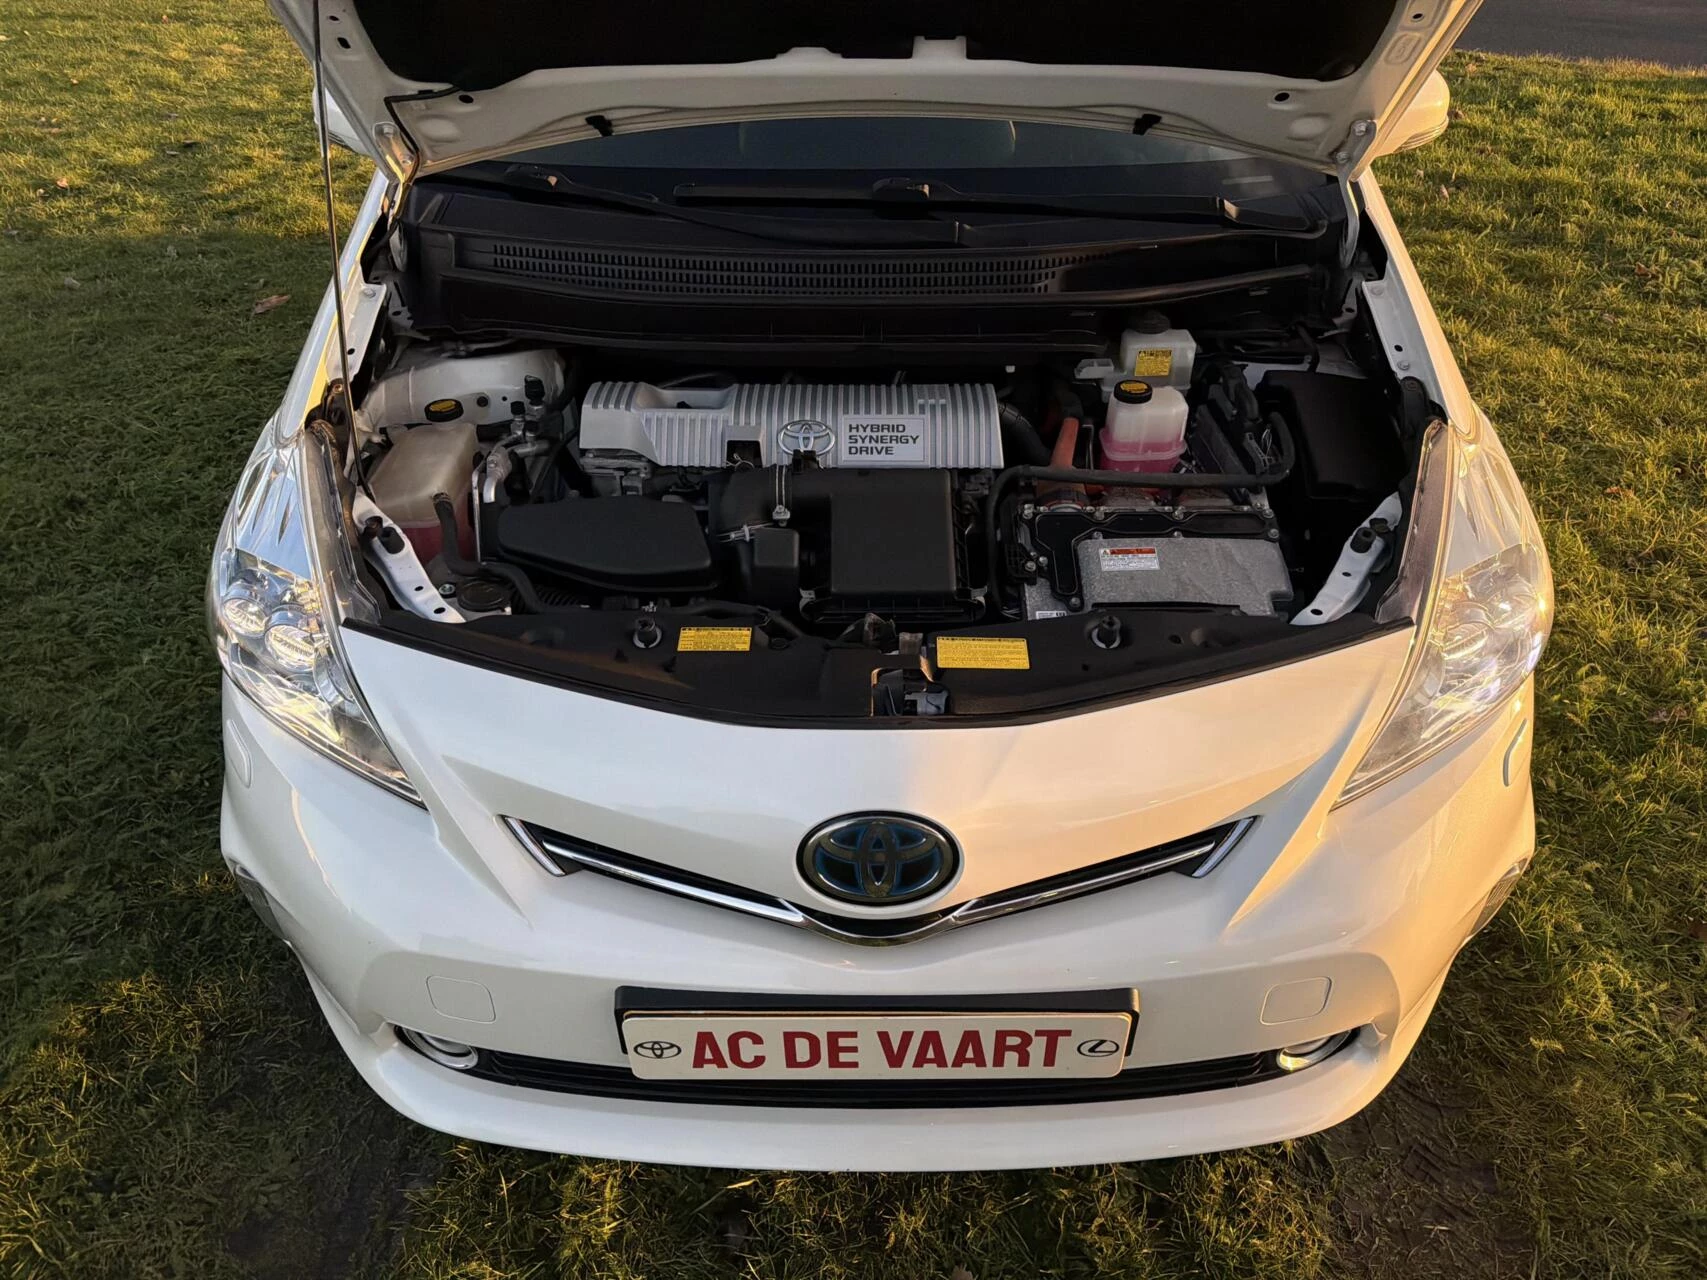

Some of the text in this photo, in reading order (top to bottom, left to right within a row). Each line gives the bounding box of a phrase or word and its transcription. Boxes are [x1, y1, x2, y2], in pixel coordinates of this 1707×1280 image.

[848, 424, 906, 433] HYBRID
[848, 435, 920, 444] SYNERGY
[848, 446, 895, 455] DRIVE
[692, 1030, 1072, 1069] AC DE VAART
